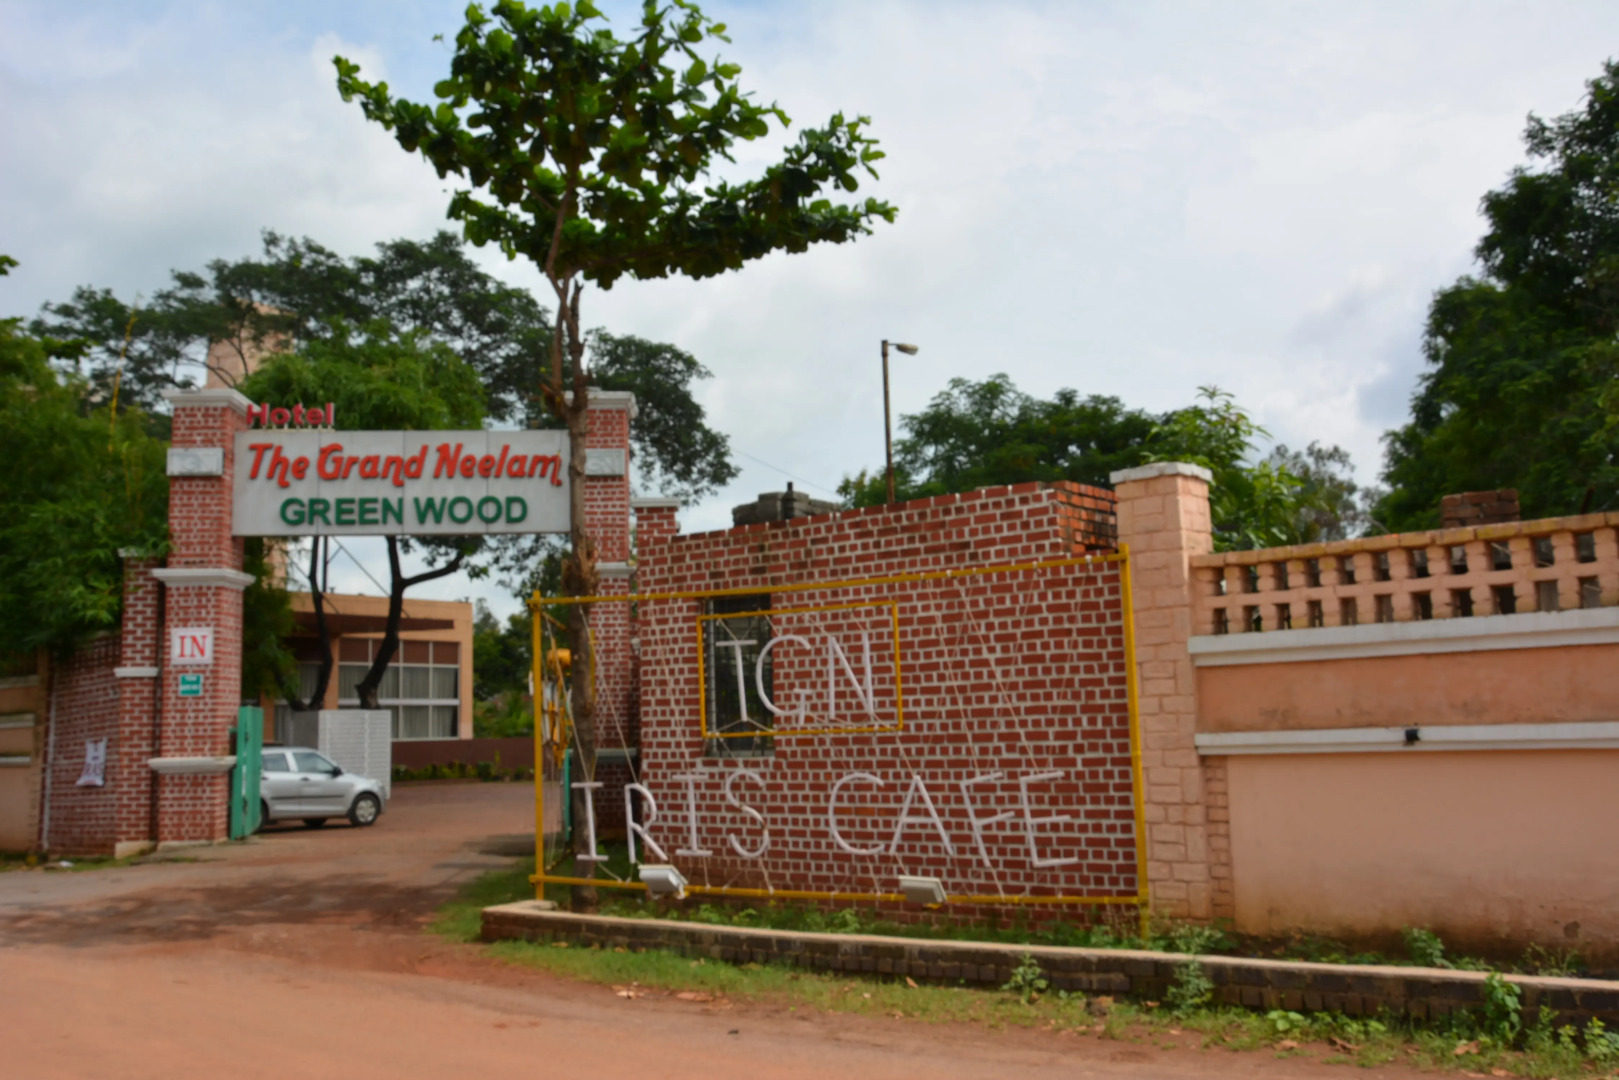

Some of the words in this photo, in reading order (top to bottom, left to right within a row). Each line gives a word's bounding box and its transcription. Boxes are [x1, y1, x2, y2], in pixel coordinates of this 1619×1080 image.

[246, 402, 334, 426] Hotel
[249, 443, 309, 488] The
[316, 443, 429, 487] Grand
[433, 443, 562, 486] Neelam
[280, 496, 403, 526] GREEN
[413, 496, 528, 524] WOOD
[178, 635, 208, 658] IN
[571, 768, 770, 864] IRIS
[828, 770, 1079, 868] CAFE
